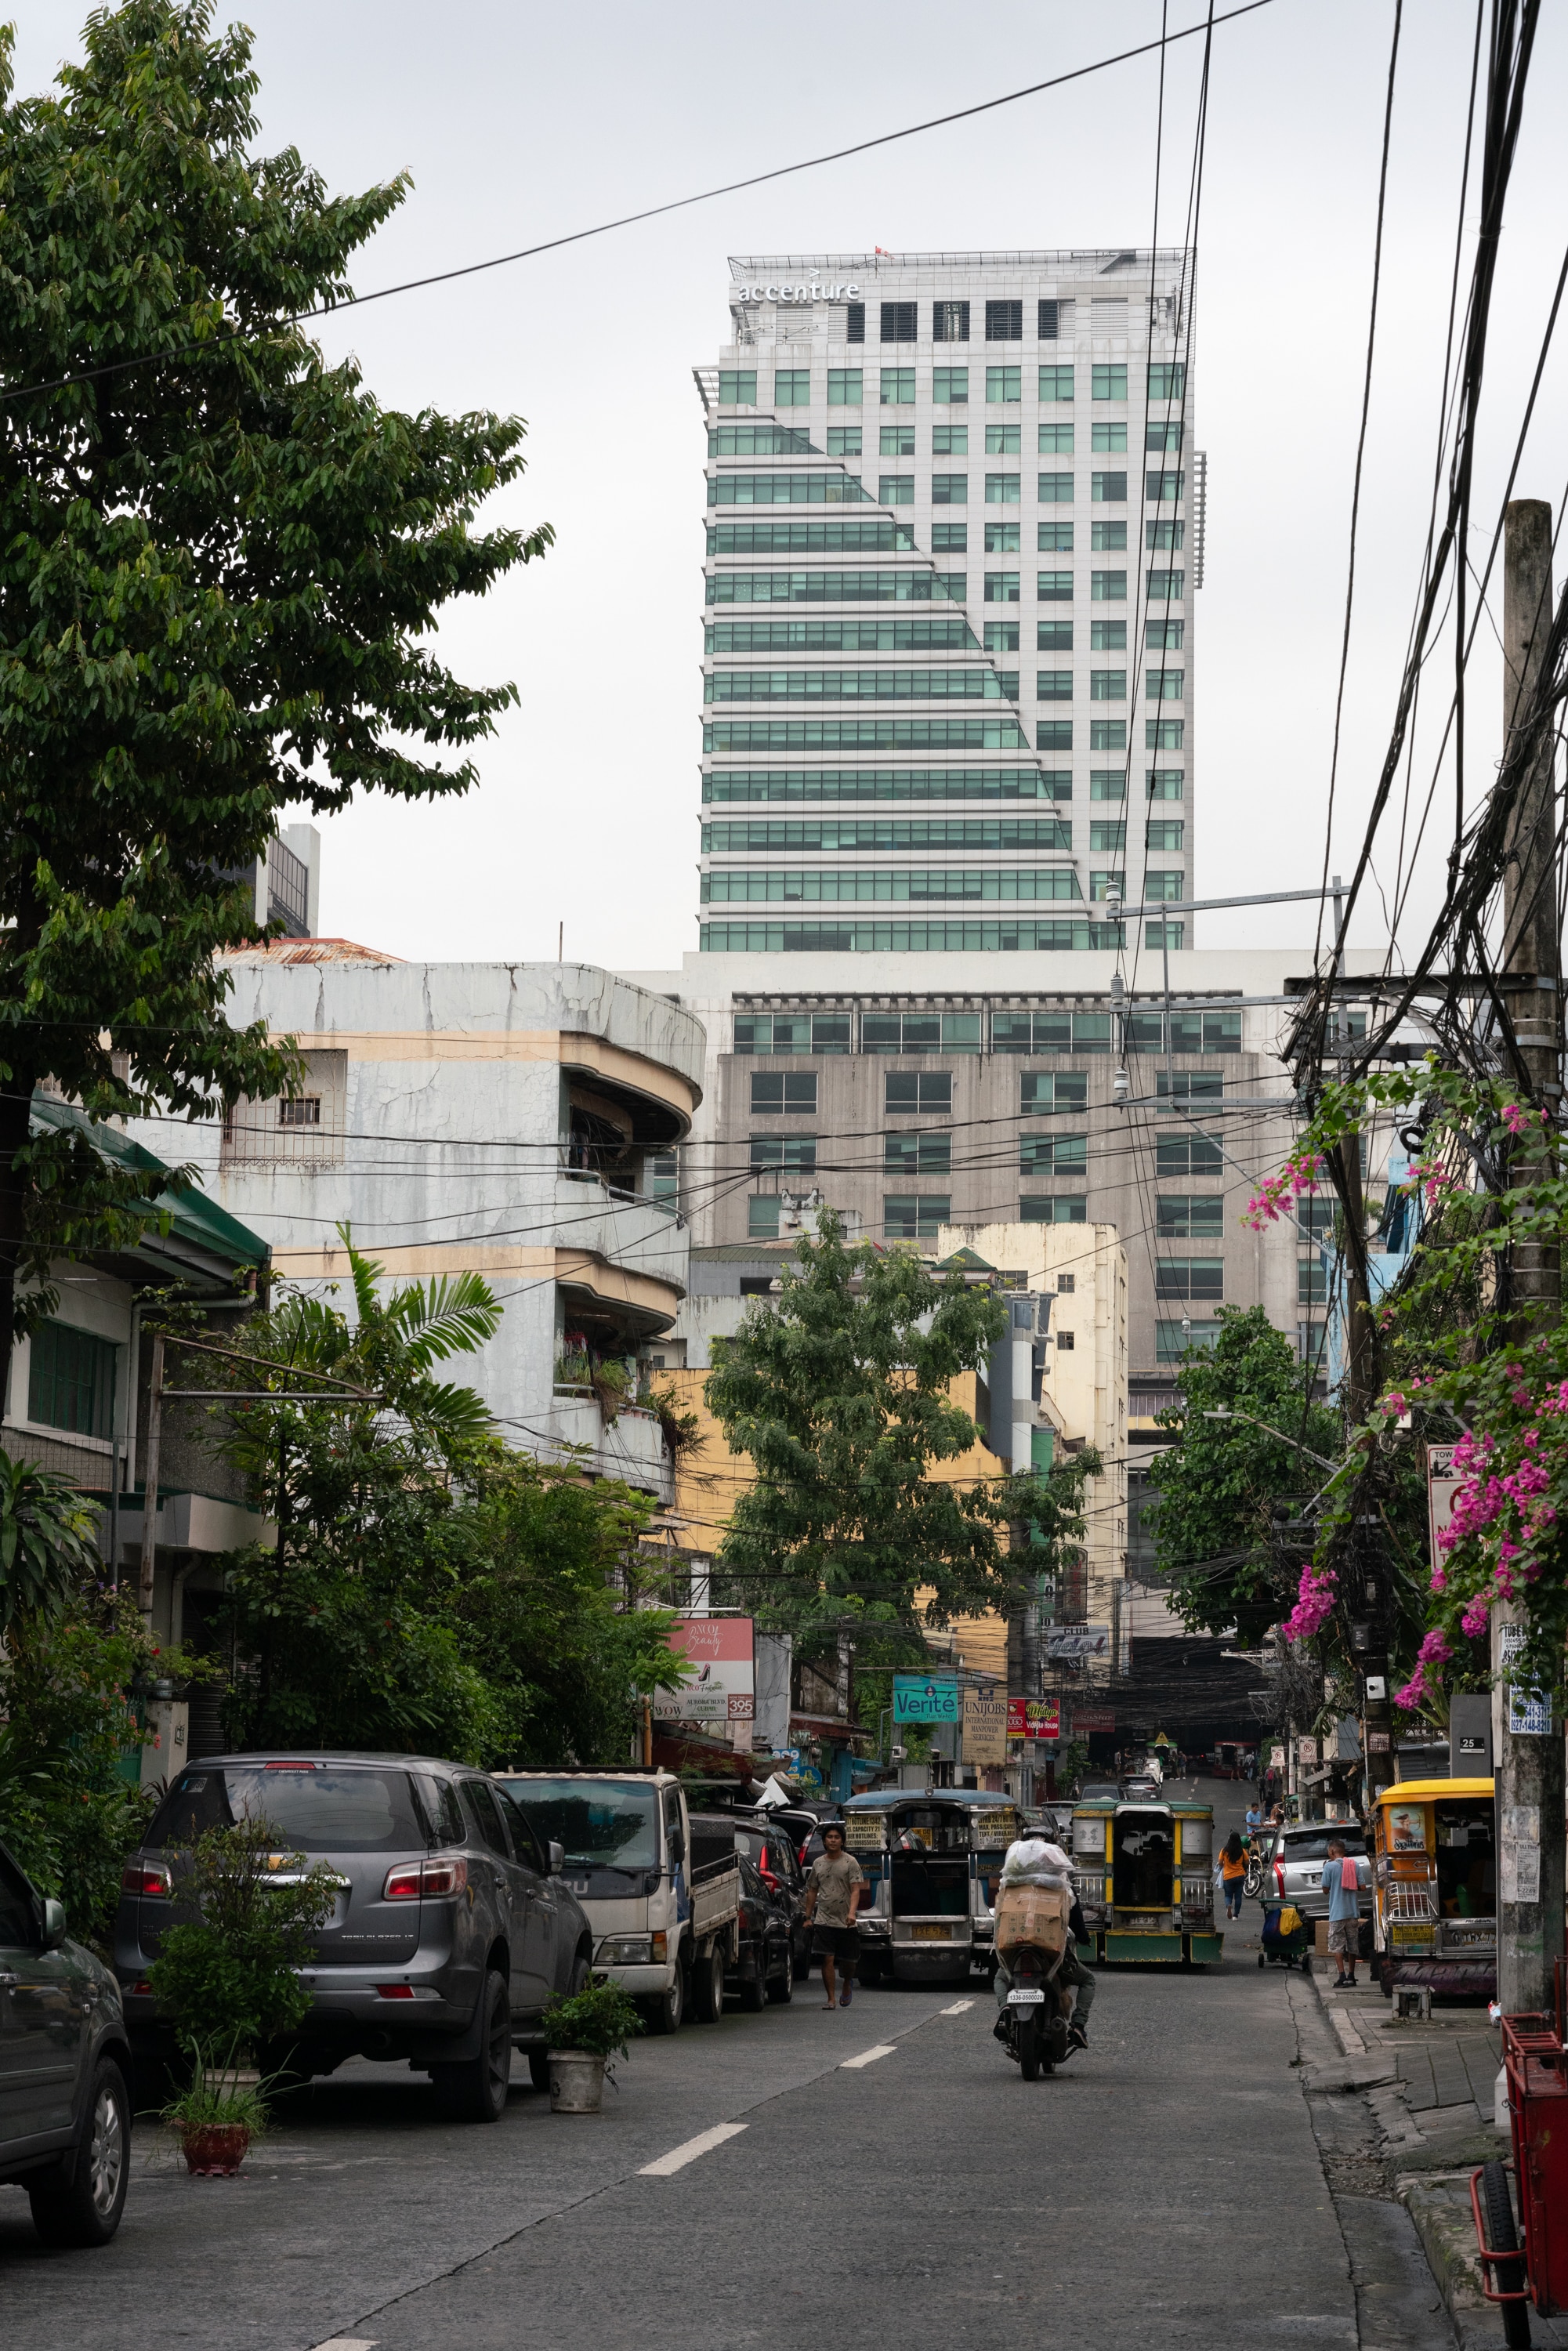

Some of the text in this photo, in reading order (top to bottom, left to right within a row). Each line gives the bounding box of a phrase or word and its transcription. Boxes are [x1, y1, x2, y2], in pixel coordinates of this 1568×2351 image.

[738, 281, 860, 302] accenture
[1063, 1627, 1089, 1636] CLUB
[1504, 1625, 1526, 1638] TUBE
[686, 1625, 723, 1657] Beauty
[729, 1700, 753, 1712] 395
[896, 1691, 955, 1714] Verité
[965, 1701, 1006, 1716] UNIJOBS
[654, 1705, 683, 1715] WOW
[1026, 1704, 1059, 1721] Mutya
[1511, 1707, 1550, 1719] 092-641-3717
[965, 1716, 1004, 1725] INTERNATIONAL
[1511, 1719, 1550, 1732] 0927-148-8210
[1461, 1738, 1475, 1748] 25
